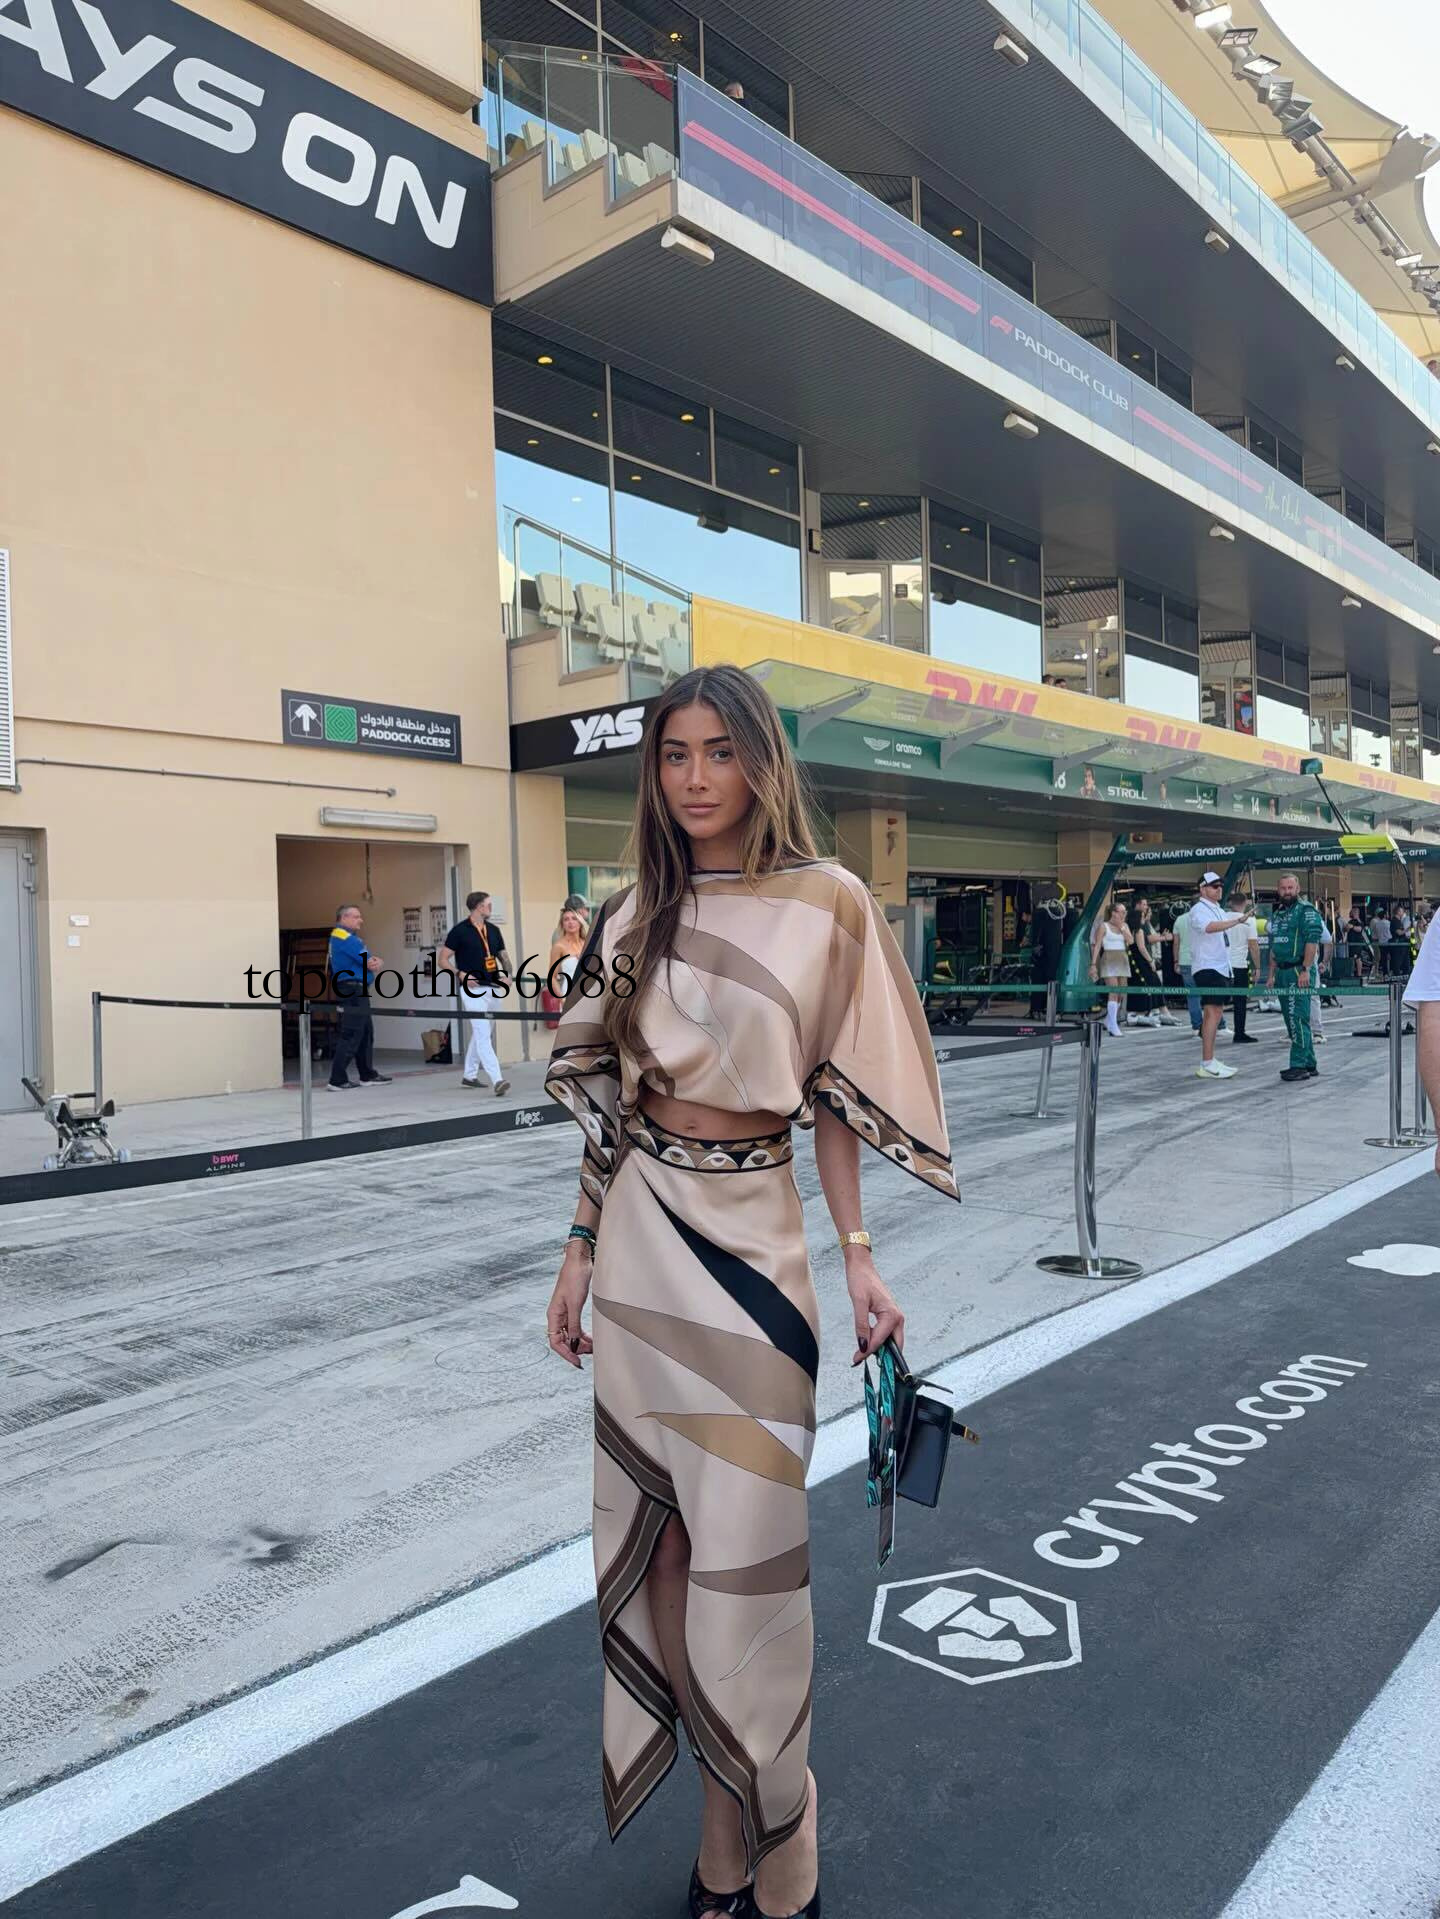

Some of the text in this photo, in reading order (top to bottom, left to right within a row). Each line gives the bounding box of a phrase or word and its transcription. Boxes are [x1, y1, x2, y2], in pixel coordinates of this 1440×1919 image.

[281, 111, 467, 249] ON
[1014, 327, 1091, 387] PADDOCK
[1092, 379, 1130, 411] CLUB
[922, 669, 1046, 739] DHL
[360, 712, 451, 735] مدخل منطقة البادوك
[570, 706, 645, 755] YAS
[361, 727, 451, 748] PADDOCK ACCESS
[895, 743, 922, 756] aramco
[1107, 785, 1149, 800] STROLL
[1251, 797, 1260, 816] 14
[1135, 846, 1235, 861] ASTON MARTIN aramco
[1299, 840, 1319, 850] arm
[1408, 848, 1427, 857] arm
[206, 1162, 246, 1172] ALPINE
[220, 1153, 239, 1163] BWT
[1033, 1354, 1368, 1569] crypto.com
